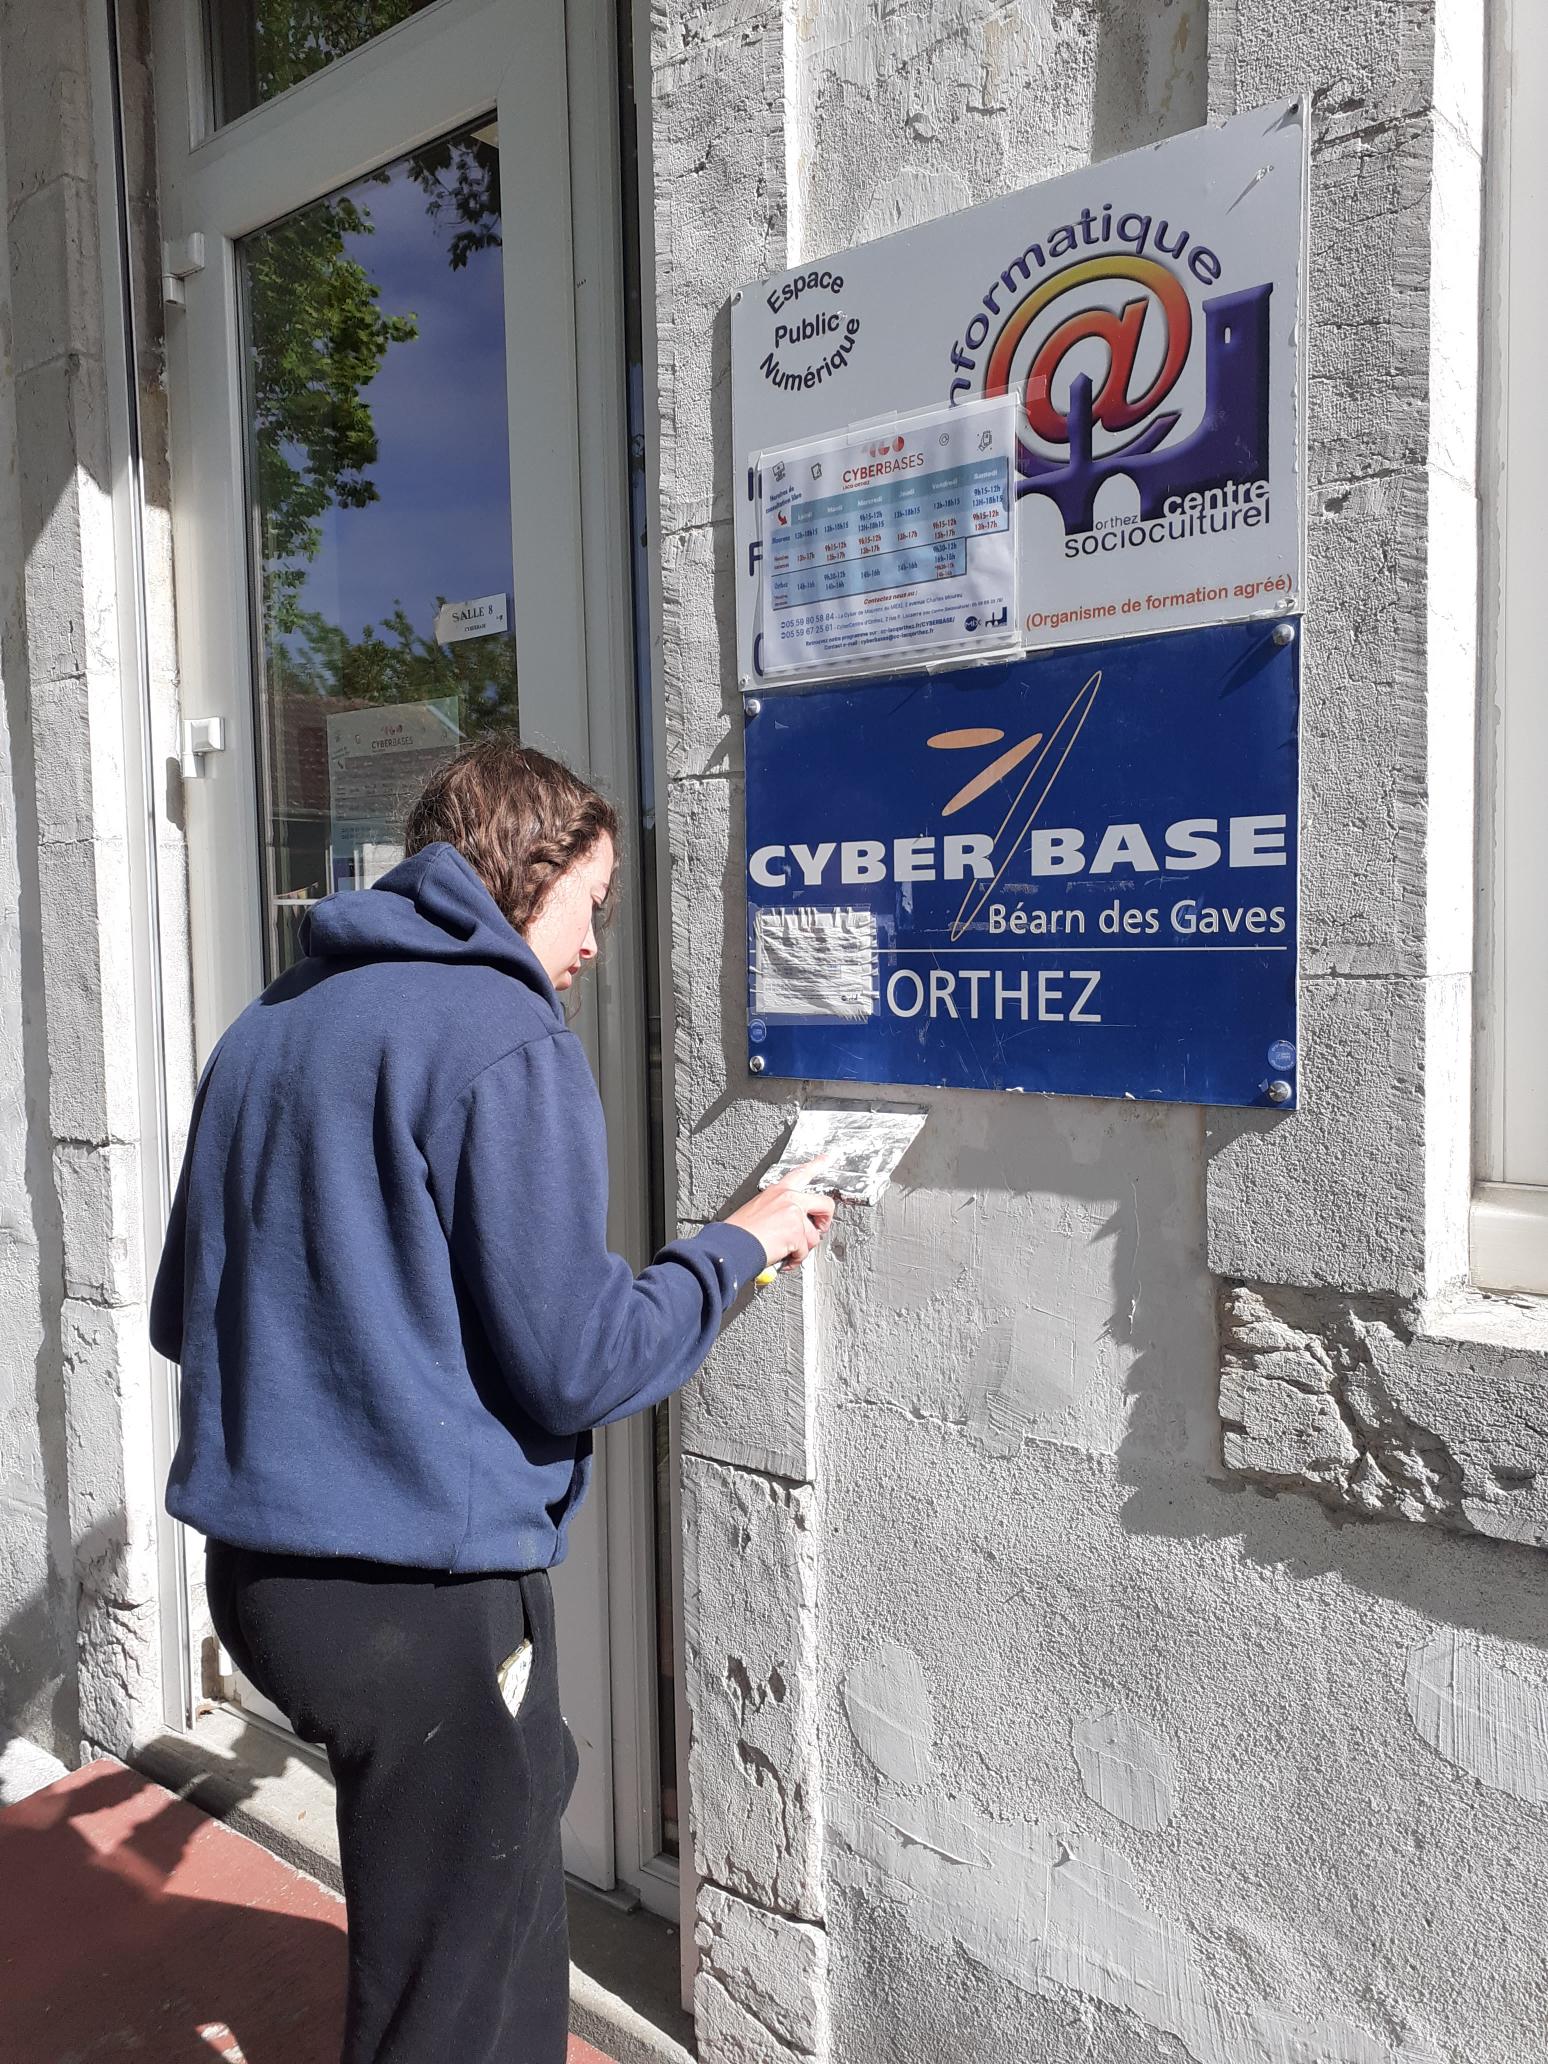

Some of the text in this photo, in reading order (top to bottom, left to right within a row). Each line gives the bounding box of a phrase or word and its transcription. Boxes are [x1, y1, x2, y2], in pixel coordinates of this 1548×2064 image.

[766, 271, 844, 314] Espace
[950, 203, 1222, 408] nformatique
[775, 312, 840, 349] Public
[760, 318, 860, 391] Numérique
[842, 453, 924, 483] CYBERBASES
[974, 469, 998, 480] Samedi
[974, 484, 1001, 496] 9h15-12h
[1163, 479, 1271, 518] centre
[1064, 501, 1271, 559] socioculturel
[1095, 514, 1139, 531] orthez
[452, 607, 485, 623] SALLE
[488, 604, 493, 615] 8
[1026, 573, 1292, 632] (Organisme de formation agréé)
[786, 619, 794, 628] 05
[796, 618, 804, 626] 59
[805, 616, 815, 625] 80
[786, 630, 794, 639] 05
[796, 629, 804, 637] 59
[805, 626, 814, 635] 67
[815, 625, 824, 634] 25
[371, 736, 414, 750] CYBERBASES
[748, 814, 1288, 888] CYBER BASE
[988, 899, 1287, 934] Béarn des Gaves
[886, 969, 1102, 1022] ORTHEZ
